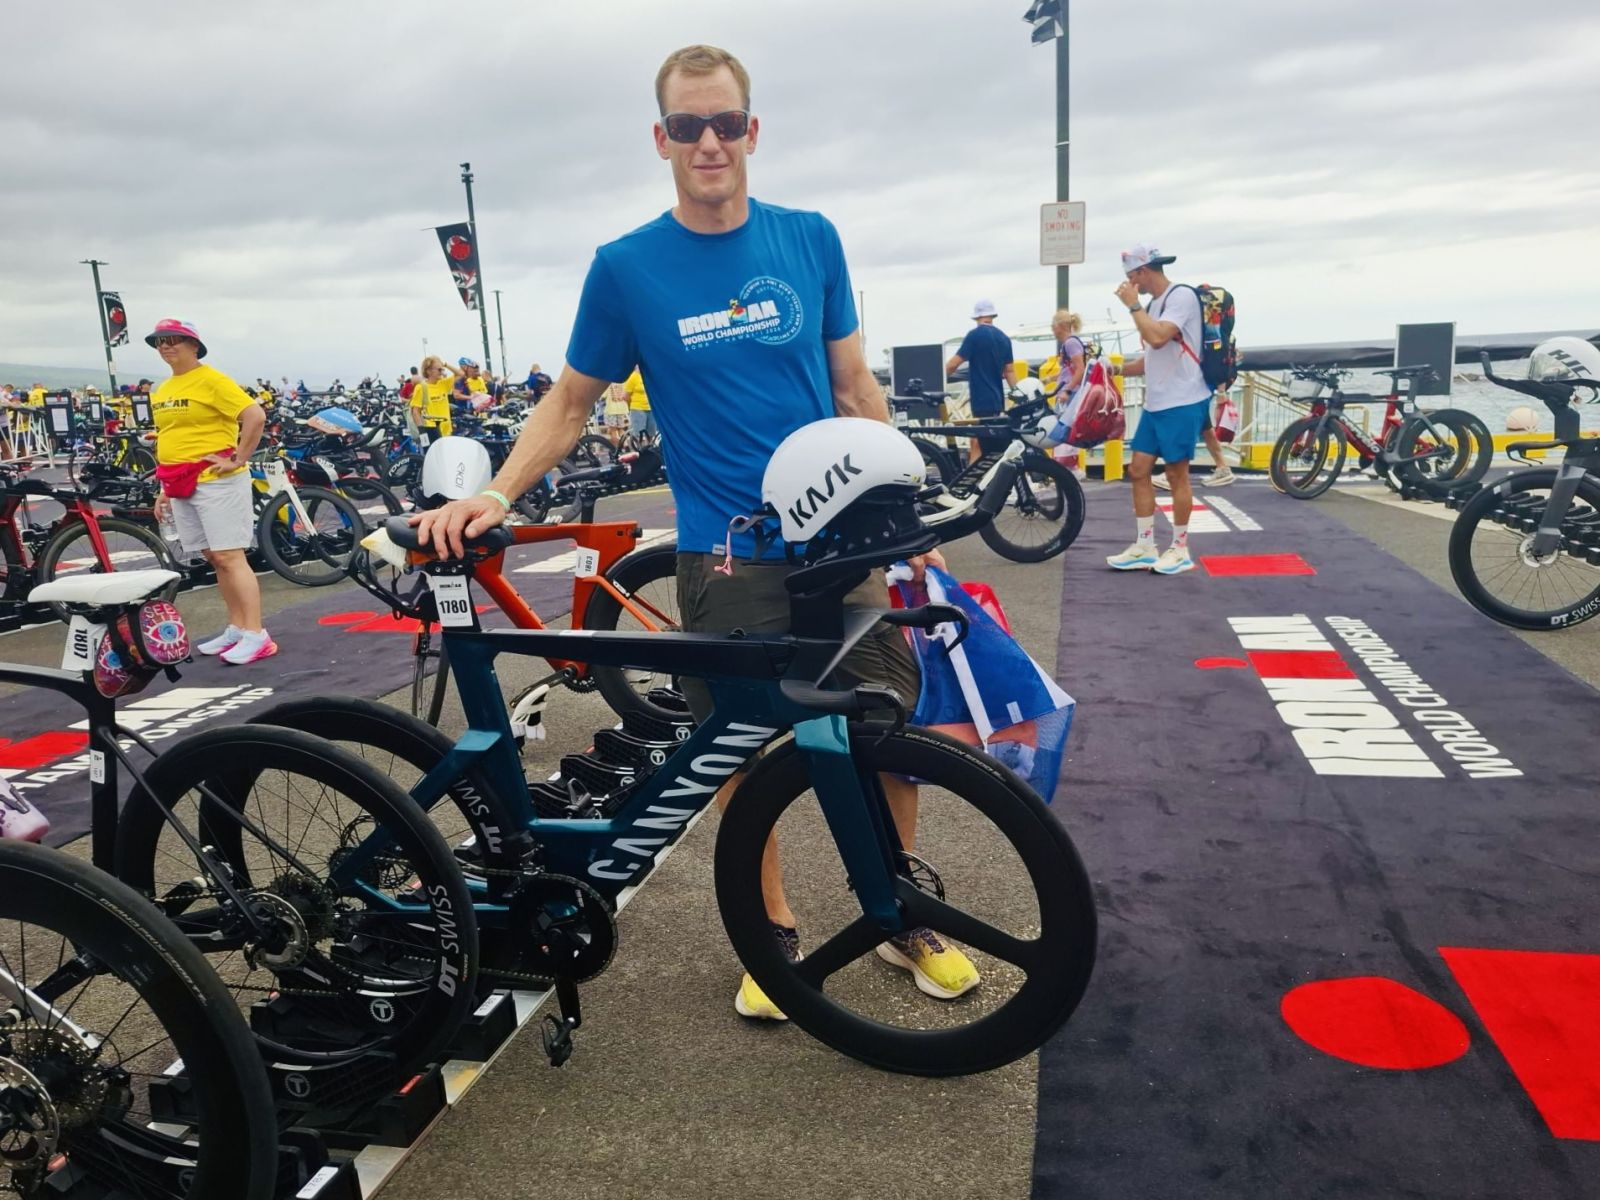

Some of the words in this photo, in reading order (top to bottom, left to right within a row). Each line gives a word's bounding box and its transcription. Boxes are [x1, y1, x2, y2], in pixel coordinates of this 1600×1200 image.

[1045, 220, 1081, 232] SMOKING
[682, 331, 715, 346] WORLD
[715, 318, 780, 340] CHAMPIONSHIP
[788, 453, 863, 529] KASK
[438, 599, 468, 614] 1780
[1551, 613, 1569, 625] DT
[1571, 596, 1600, 620] SWISS
[73, 629, 88, 659] 1807
[167, 646, 185, 660] ME
[1325, 616, 1448, 708] CHAMPIONSHIP
[1413, 710, 1524, 779] WORLD
[452, 779, 490, 816] SWI
[587, 722, 779, 880] CANYON
[428, 885, 459, 954] SWISS
[438, 956, 459, 997] DT
